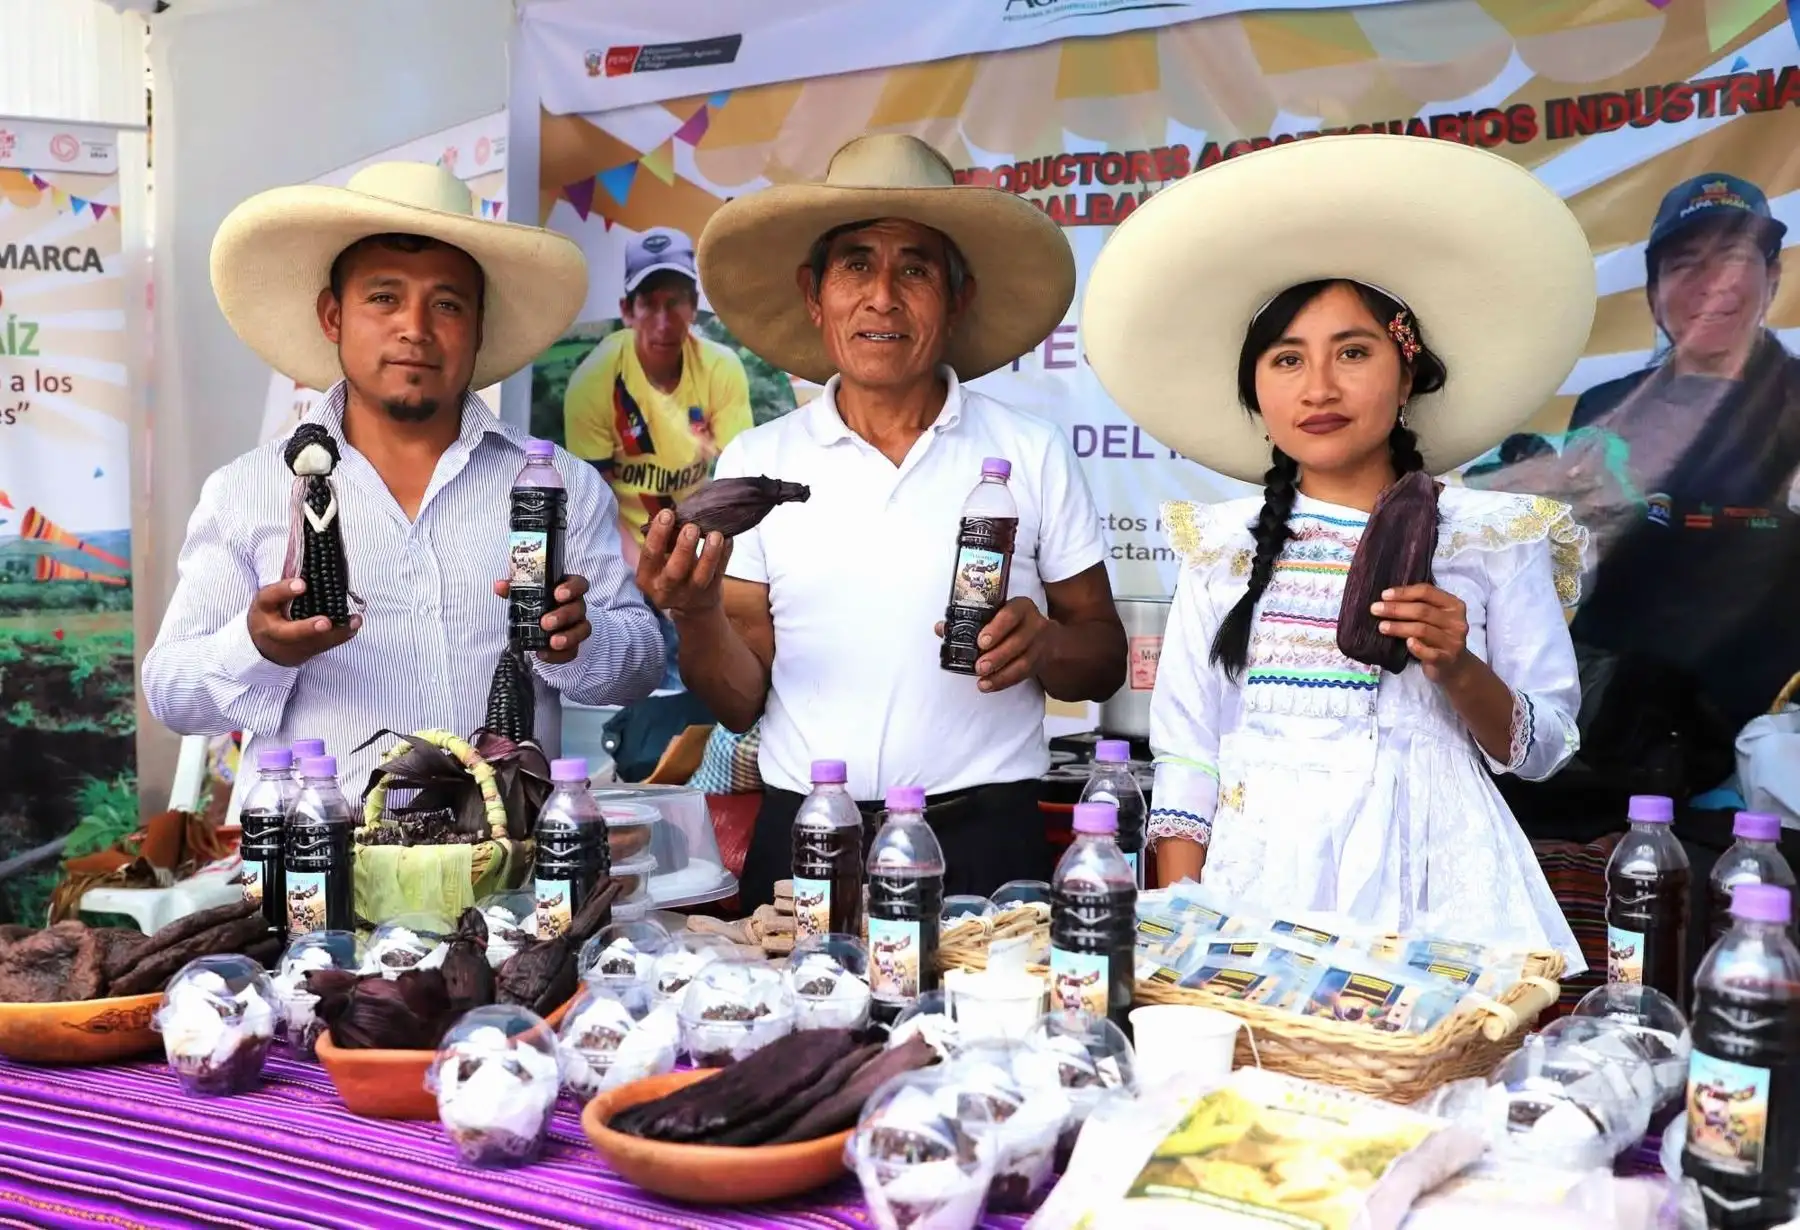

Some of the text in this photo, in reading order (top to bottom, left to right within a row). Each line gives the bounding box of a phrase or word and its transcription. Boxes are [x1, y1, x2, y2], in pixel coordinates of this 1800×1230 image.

[0, 244, 104, 273] MARCA
[0, 314, 40, 357] ÍZ
[11, 369, 73, 393] a los
[1073, 425, 1155, 458] DEL
[1100, 513, 1148, 532] tos
